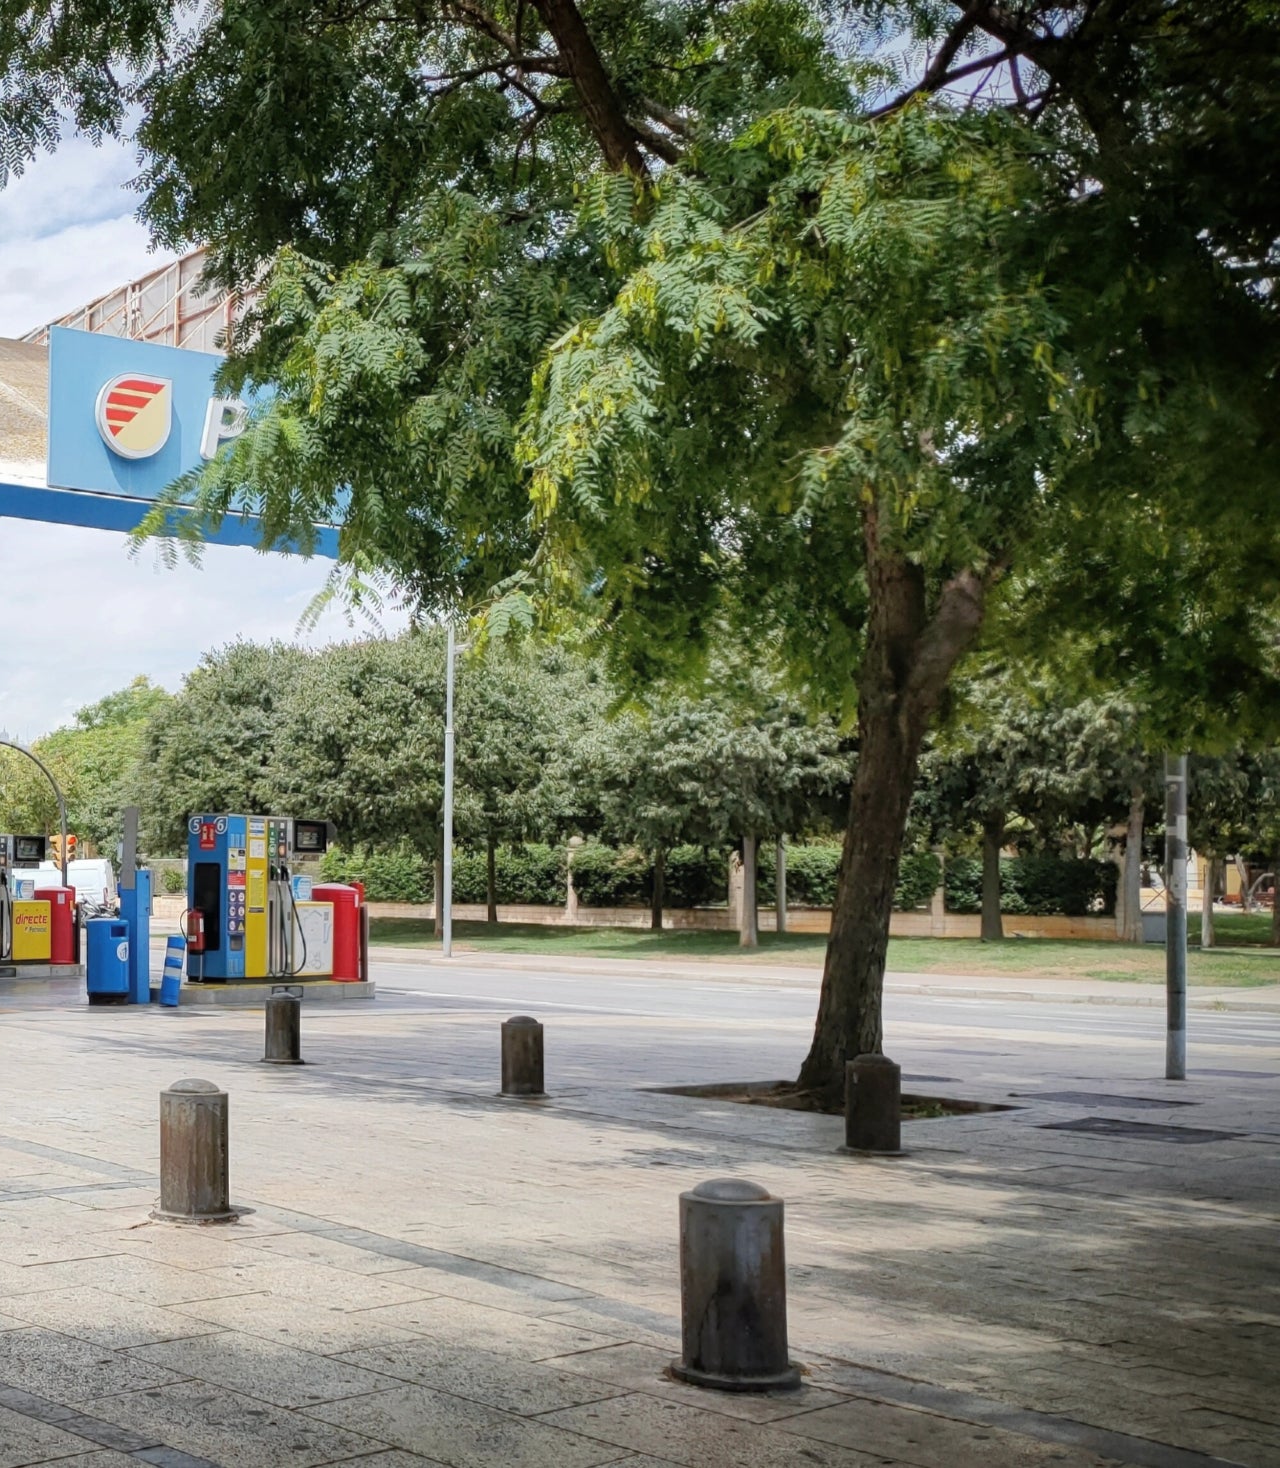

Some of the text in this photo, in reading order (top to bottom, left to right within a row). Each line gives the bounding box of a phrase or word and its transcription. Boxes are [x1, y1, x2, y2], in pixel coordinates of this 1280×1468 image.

[193, 819, 200, 831] 5
[217, 819, 224, 831] 6
[15, 914, 48, 925] directe
